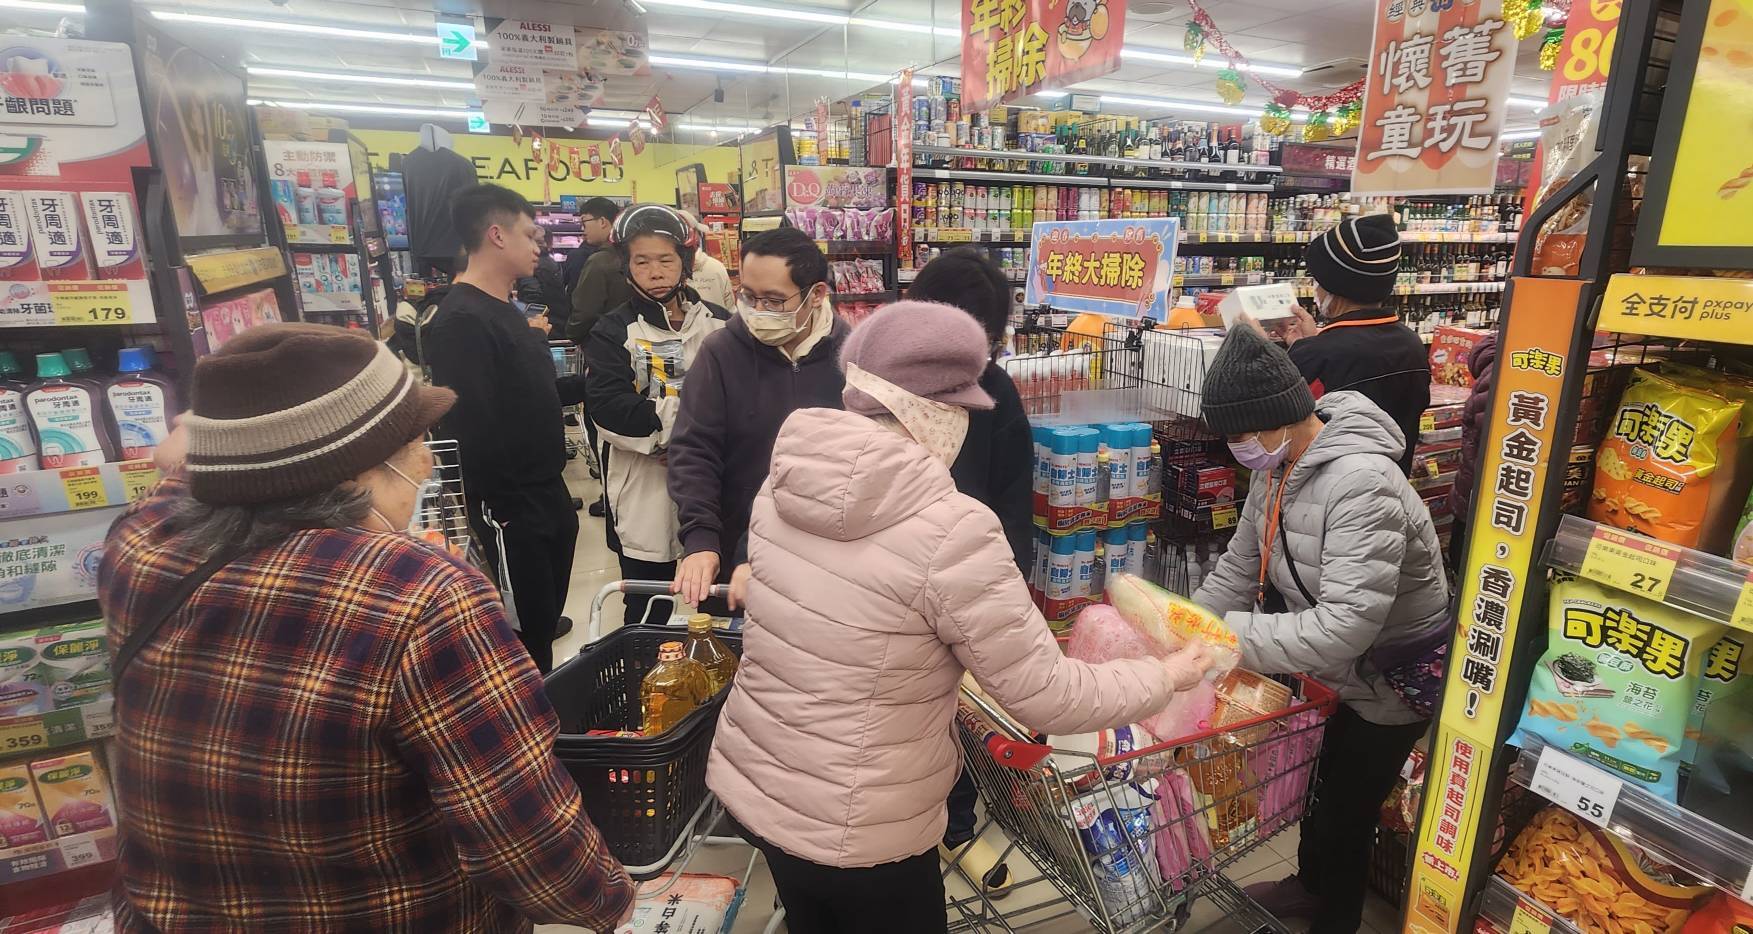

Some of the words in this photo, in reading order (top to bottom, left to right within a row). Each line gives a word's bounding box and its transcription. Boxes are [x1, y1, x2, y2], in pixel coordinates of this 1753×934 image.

[520, 22, 551, 32] ALESSI
[986, 22, 1049, 100] 掃除
[1377, 18, 1505, 97] 懷舊
[1365, 98, 1492, 161] 童玩
[476, 156, 624, 183] EAFOOD
[40, 198, 68, 246] 牙周適
[97, 199, 125, 246] 牙周適
[1046, 250, 1147, 291] 年終大掃除
[88, 307, 127, 320] 179
[1621, 292, 1699, 320] 全支付
[1699, 310, 1731, 321] plus
[1702, 299, 1753, 314] pxpay
[35, 395, 78, 404] parodontax
[76, 490, 99, 500] 199
[1629, 572, 1662, 593] 27
[1626, 682, 1658, 700] 海苔
[6, 734, 42, 748] 359
[1576, 796, 1605, 818] 55
